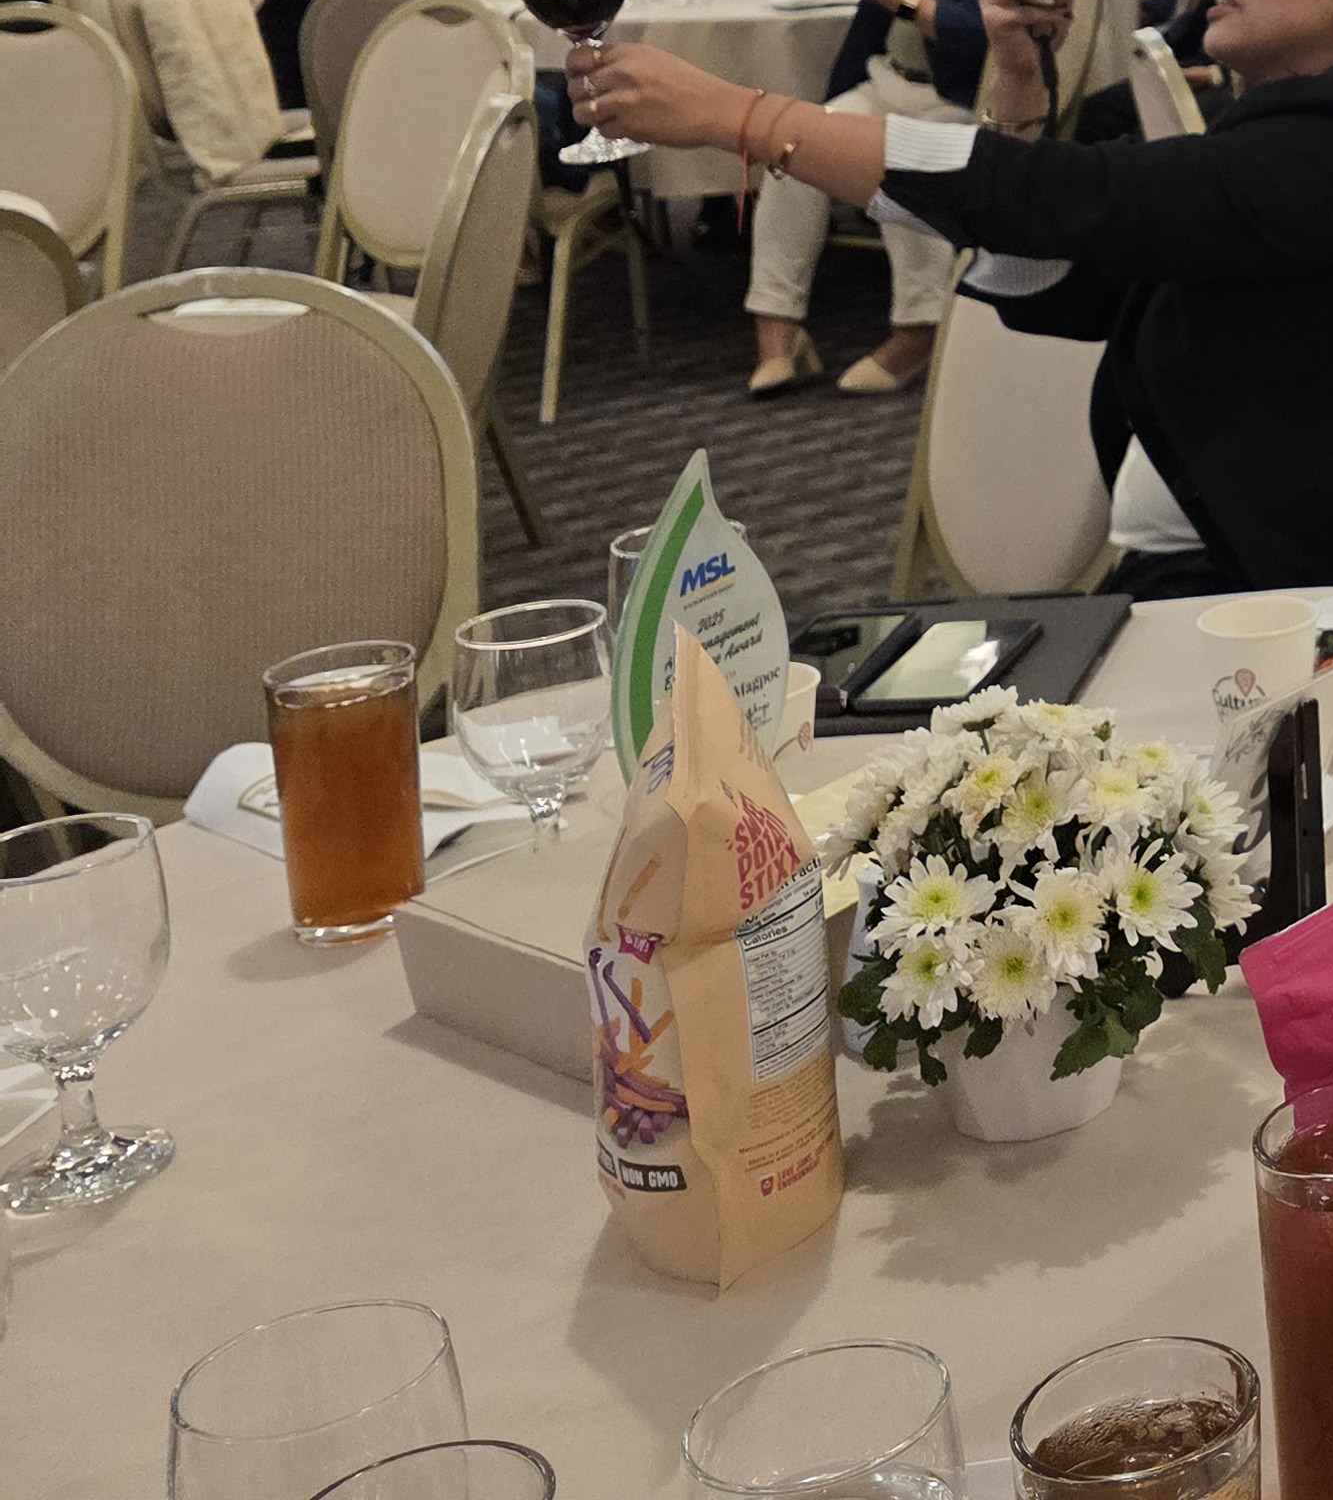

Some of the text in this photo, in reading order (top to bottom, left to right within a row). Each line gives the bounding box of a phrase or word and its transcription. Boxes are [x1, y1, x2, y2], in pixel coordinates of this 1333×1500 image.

[680, 552, 735, 598] MSL
[739, 838, 801, 911] STIXX
[743, 925, 788, 947] Calories
[622, 1164, 678, 1188] NON GMO
